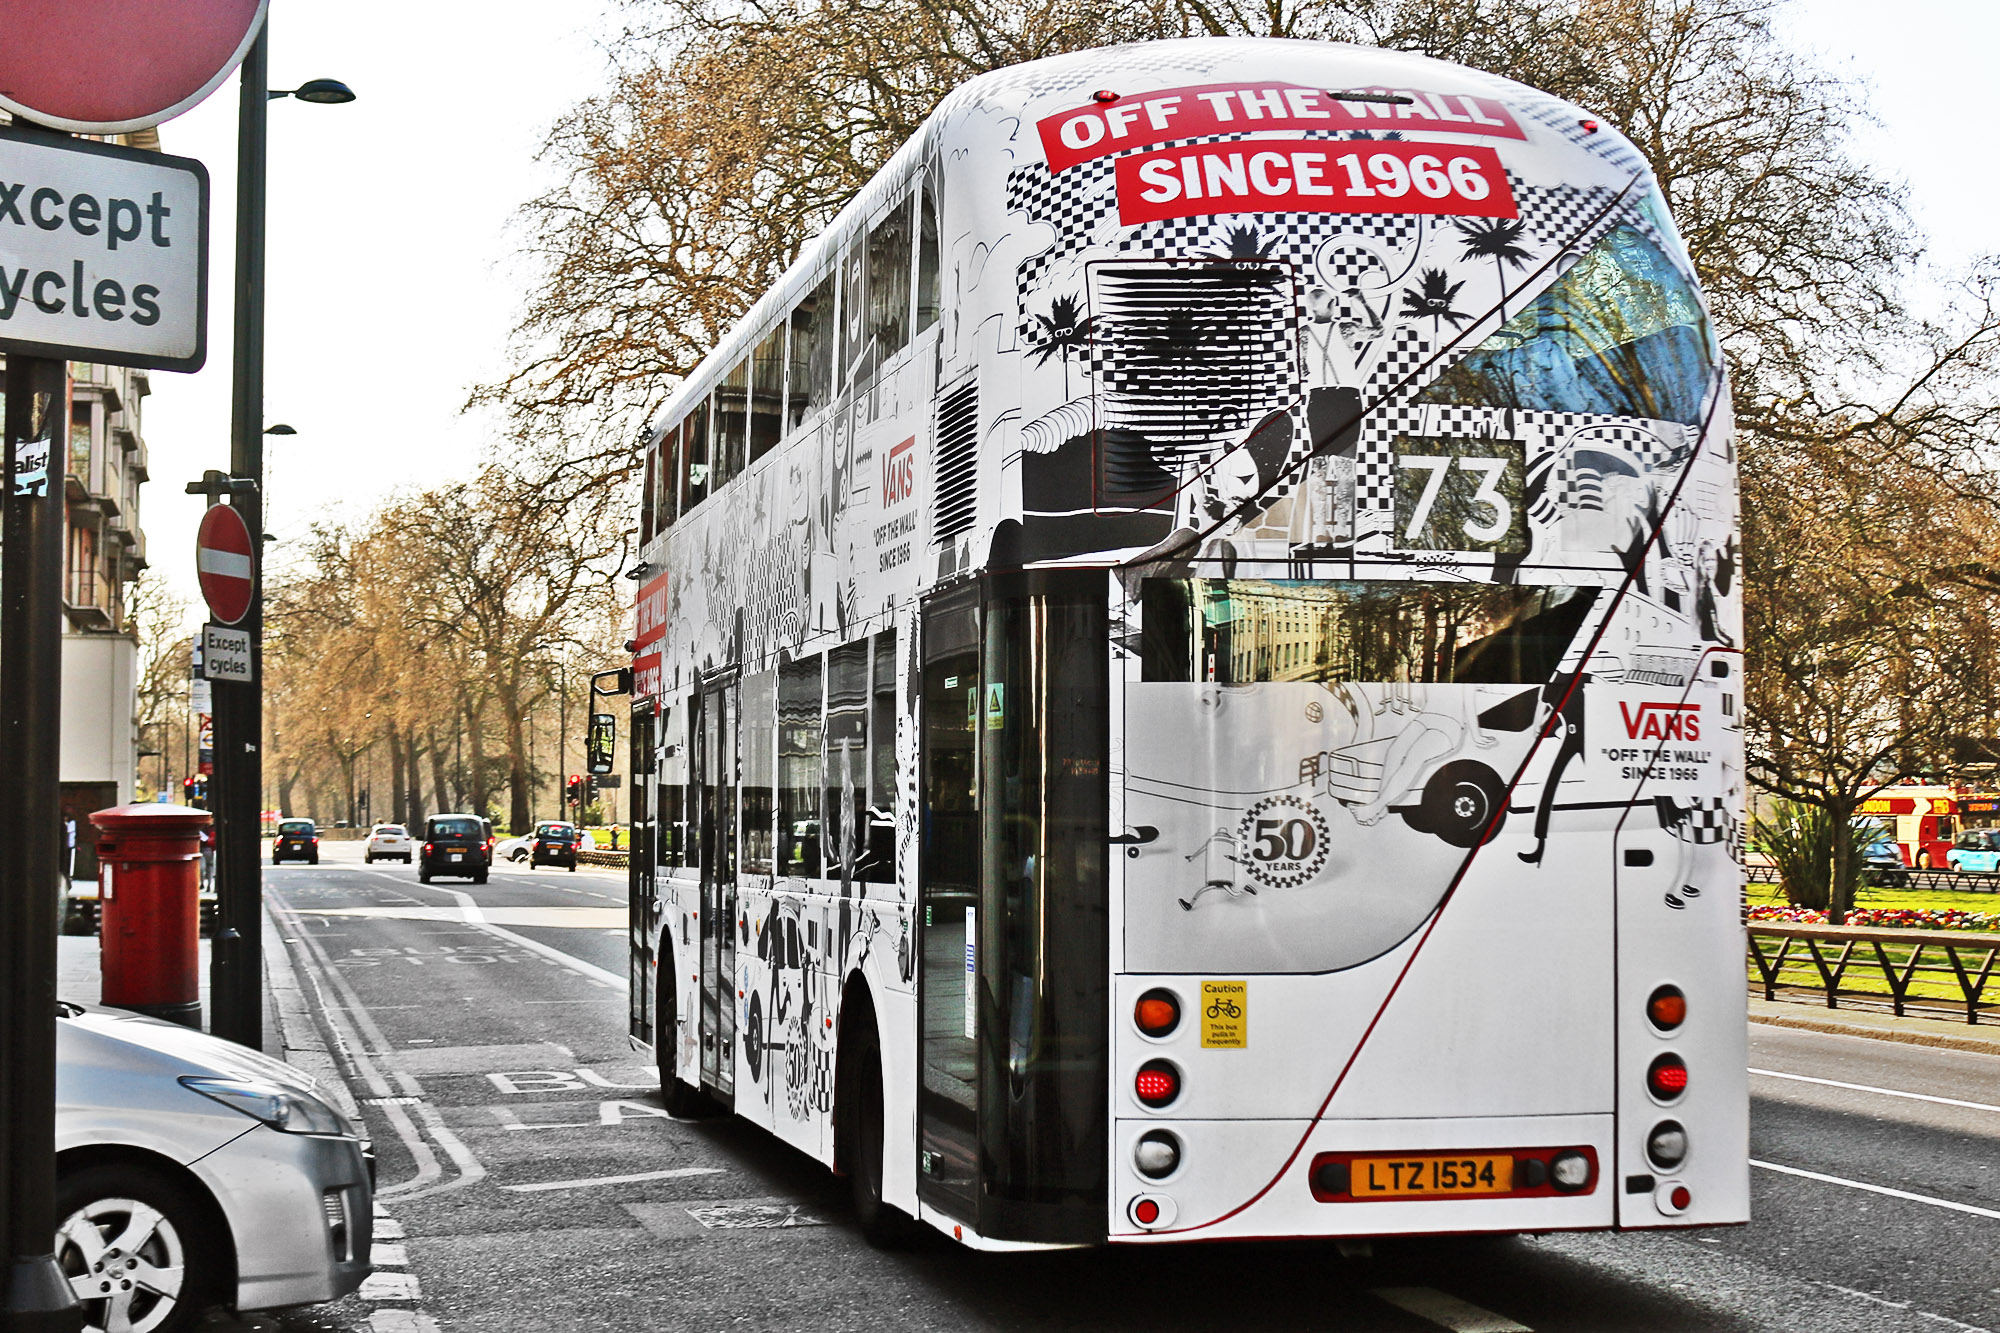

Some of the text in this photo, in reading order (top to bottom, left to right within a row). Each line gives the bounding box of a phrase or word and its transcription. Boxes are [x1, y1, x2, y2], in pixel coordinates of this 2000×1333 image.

[1060, 88, 1505, 149] OFF THE WALL
[1138, 151, 1490, 204] SINCE 1966
[0, 181, 171, 250] xcept
[0, 259, 161, 326] ycles
[15, 452, 48, 474] alist
[882, 434, 915, 509] VANS
[1399, 455, 1512, 542] 73
[887, 518, 899, 541] THE
[879, 548, 896, 573] SINCE
[208, 633, 247, 653] Except
[210, 657, 247, 675] cycles
[1618, 701, 1702, 741] VANS
[1642, 749, 1671, 763] THE
[1621, 766, 1699, 781] SINCE 1966
[1252, 818, 1316, 862] 50
[1265, 862, 1302, 871] YEARS
[1204, 984, 1244, 993] Caution
[1206, 1038, 1241, 1046] frequently
[486, 1065, 661, 1094] BU
[788, 1043, 800, 1091] 50
[488, 1100, 700, 1131] LA
[1369, 1160, 1496, 1191] LTZ 1534
